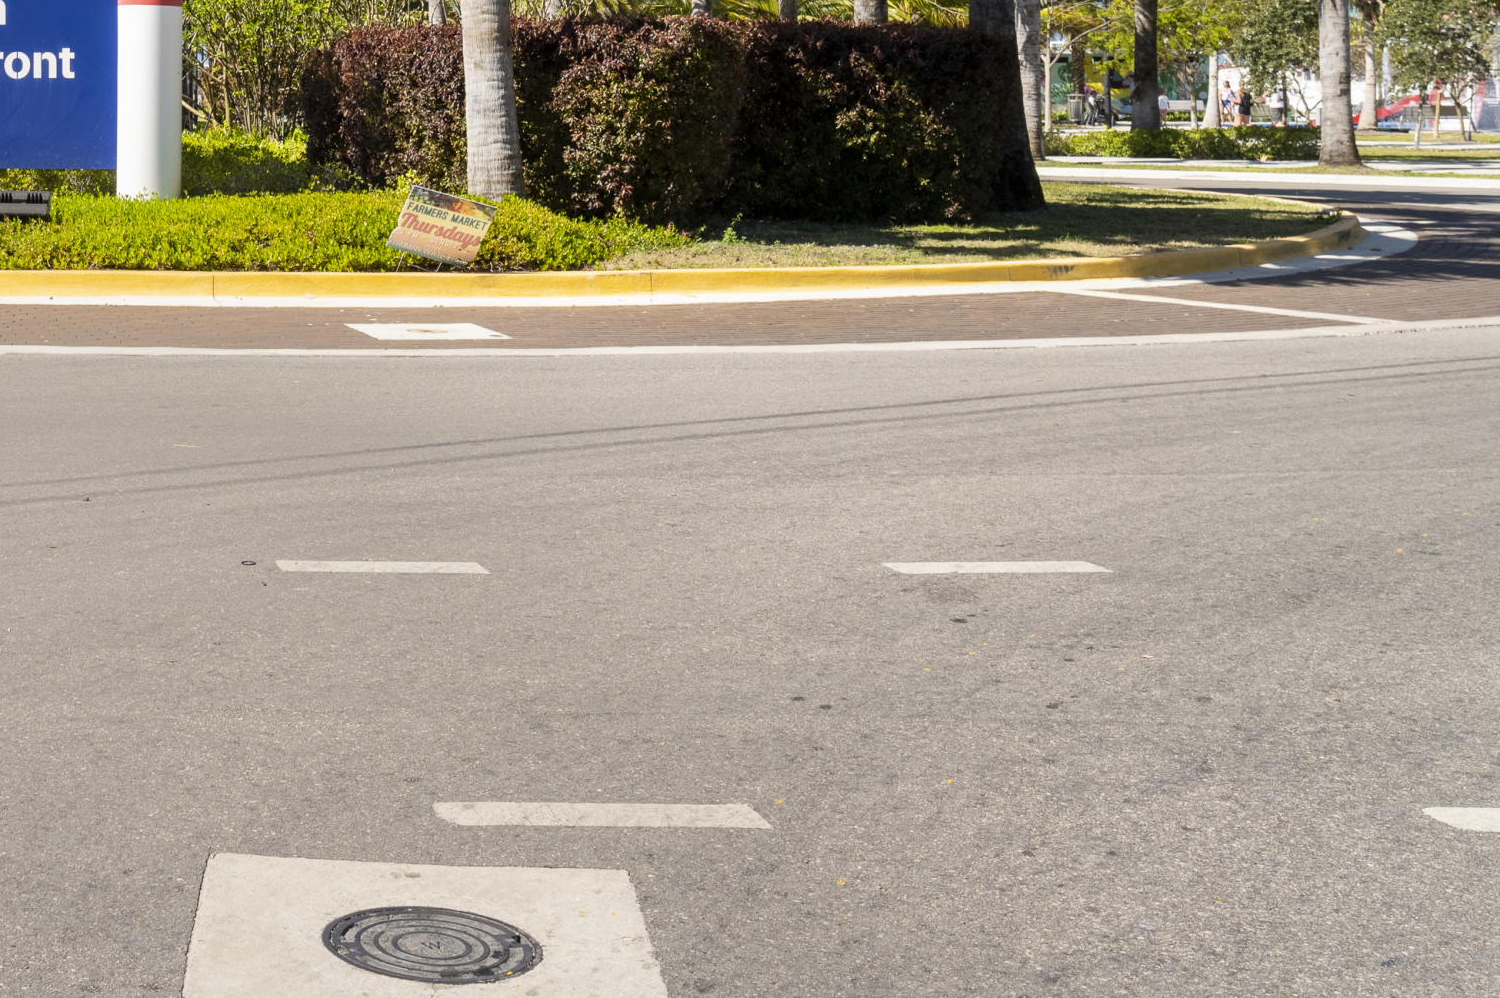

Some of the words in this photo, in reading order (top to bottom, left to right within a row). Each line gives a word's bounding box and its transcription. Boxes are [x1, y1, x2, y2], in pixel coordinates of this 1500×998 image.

[400, 212, 482, 249] Thursdays
[406, 201, 449, 220] FARMERS
[451, 213, 489, 231] MARKET
